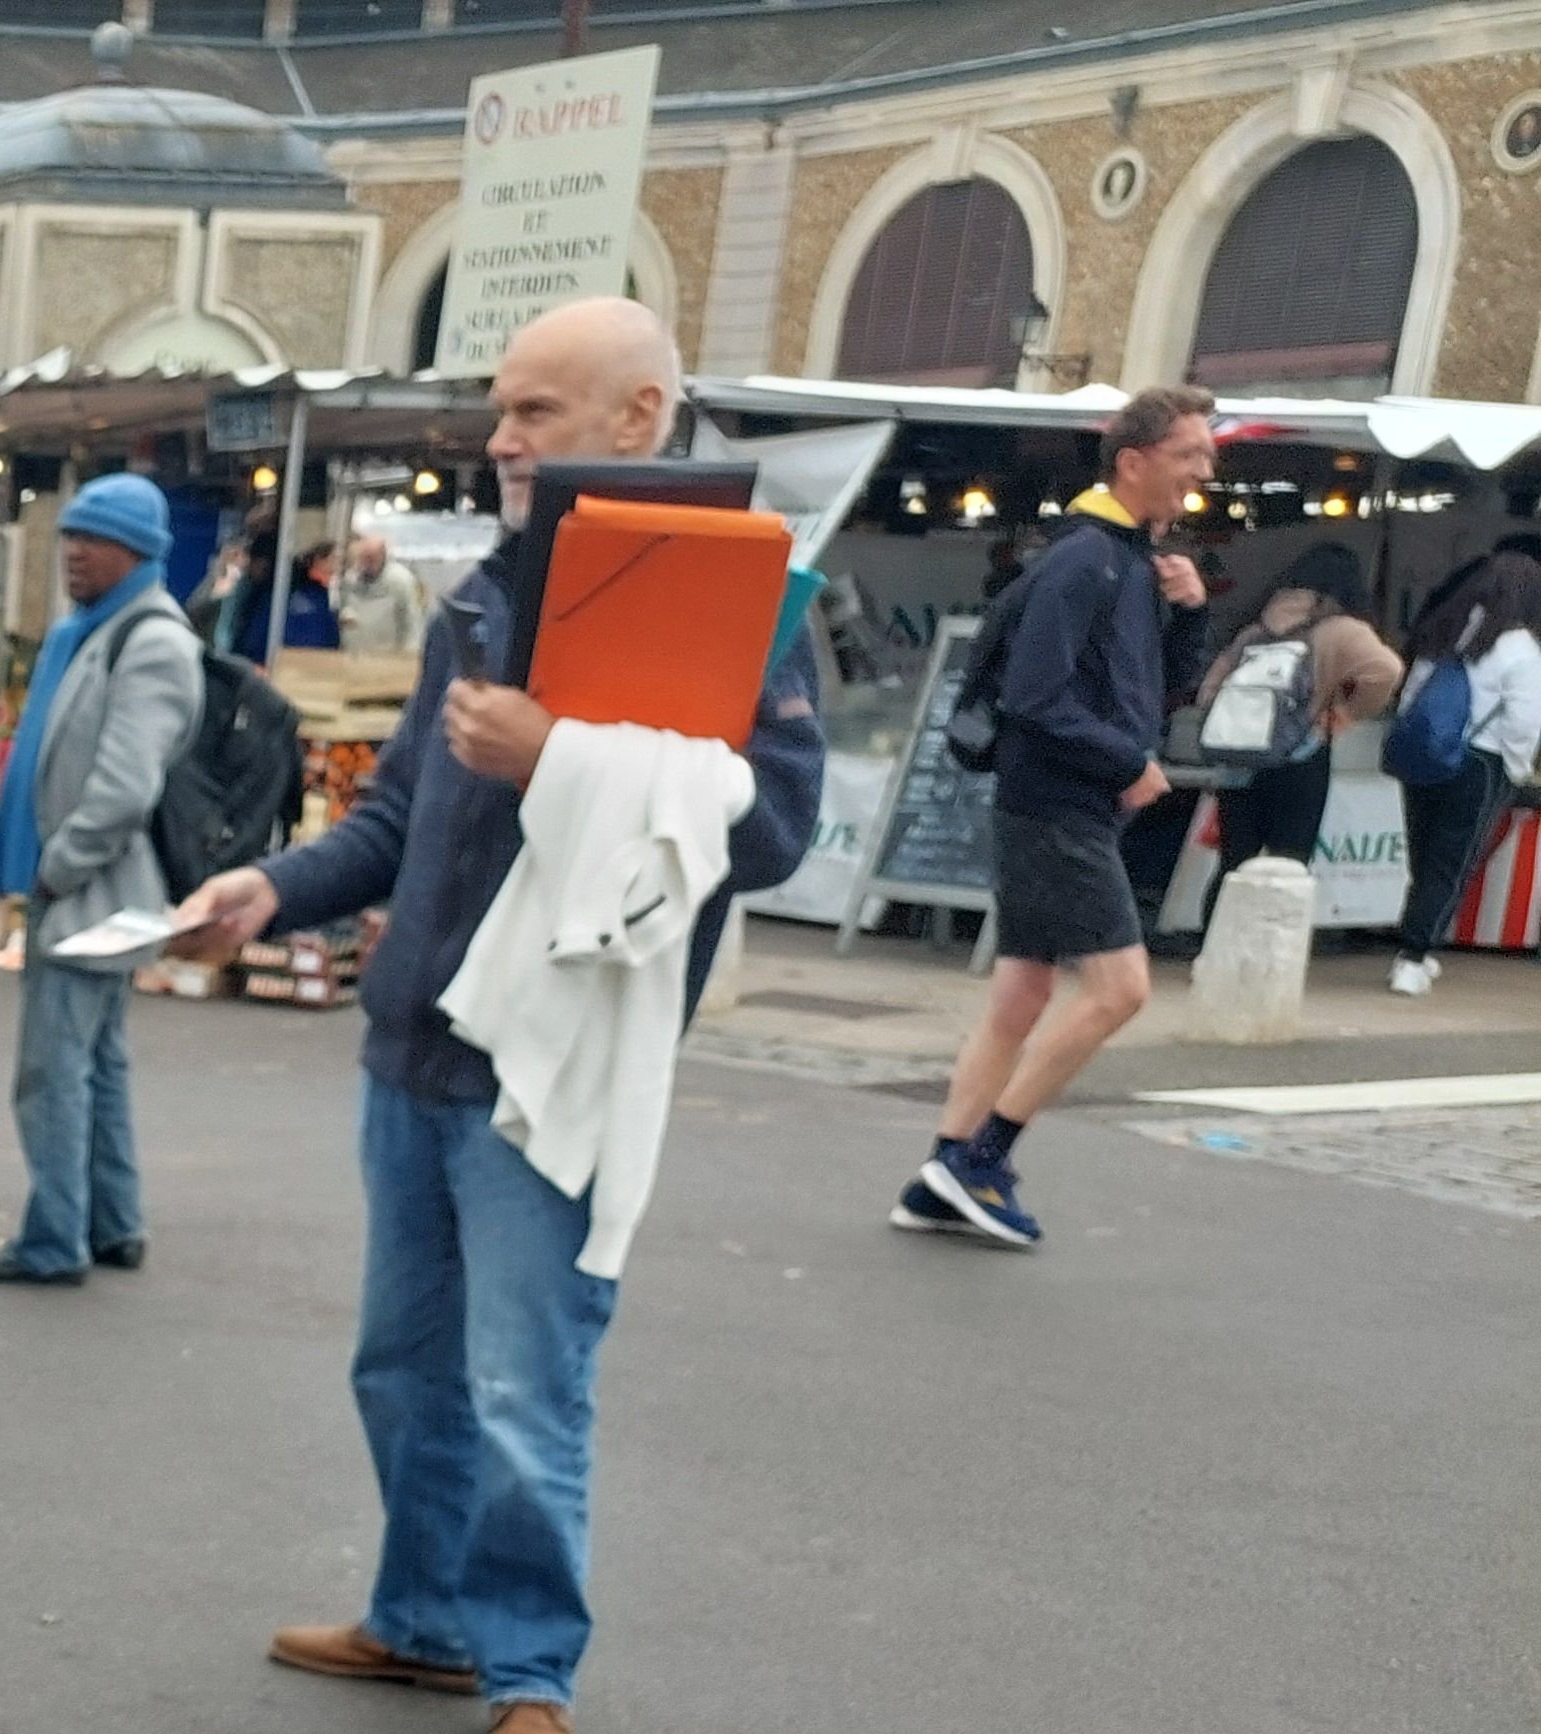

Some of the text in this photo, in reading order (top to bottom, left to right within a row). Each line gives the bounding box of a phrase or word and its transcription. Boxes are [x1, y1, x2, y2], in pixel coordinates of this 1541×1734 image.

[514, 93, 624, 139] RAPPEL
[481, 170, 606, 205] CIRCULATION
[522, 209, 548, 232] ET
[464, 234, 614, 267] STATIONNEMENT
